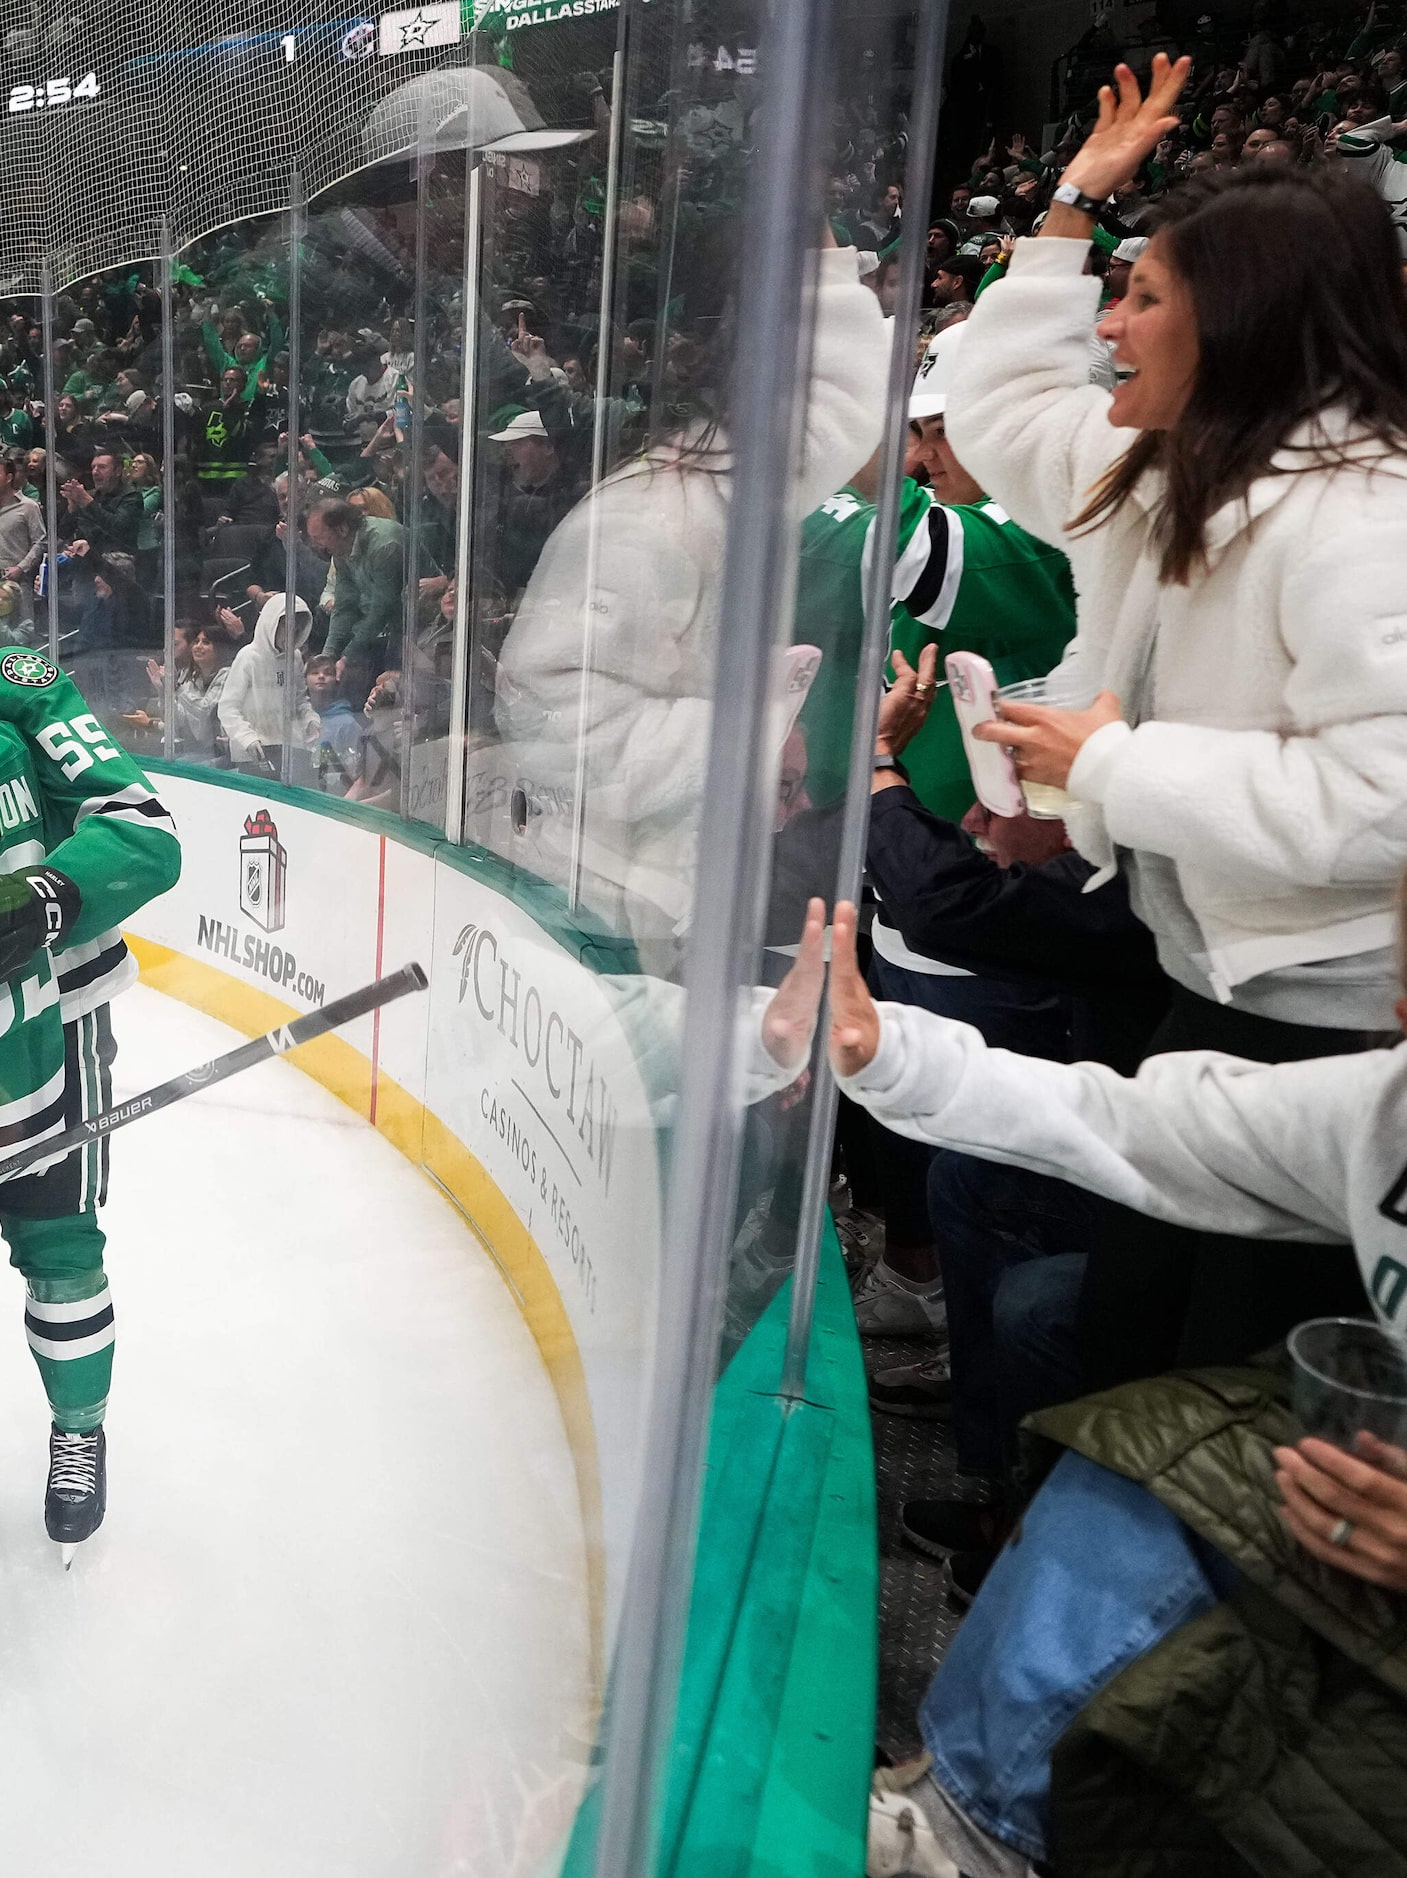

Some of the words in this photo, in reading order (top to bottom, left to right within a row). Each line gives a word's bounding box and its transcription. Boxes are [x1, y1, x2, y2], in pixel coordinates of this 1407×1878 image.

[280, 35, 294, 62] 1
[8, 72, 101, 113] 2:54
[44, 870, 66, 888] HARLEY
[197, 914, 326, 1008] NHLSHOP.COM
[473, 928, 618, 1200] CHOCTAW
[480, 1086, 538, 1185] CASINOS
[539, 1166, 549, 1200] &
